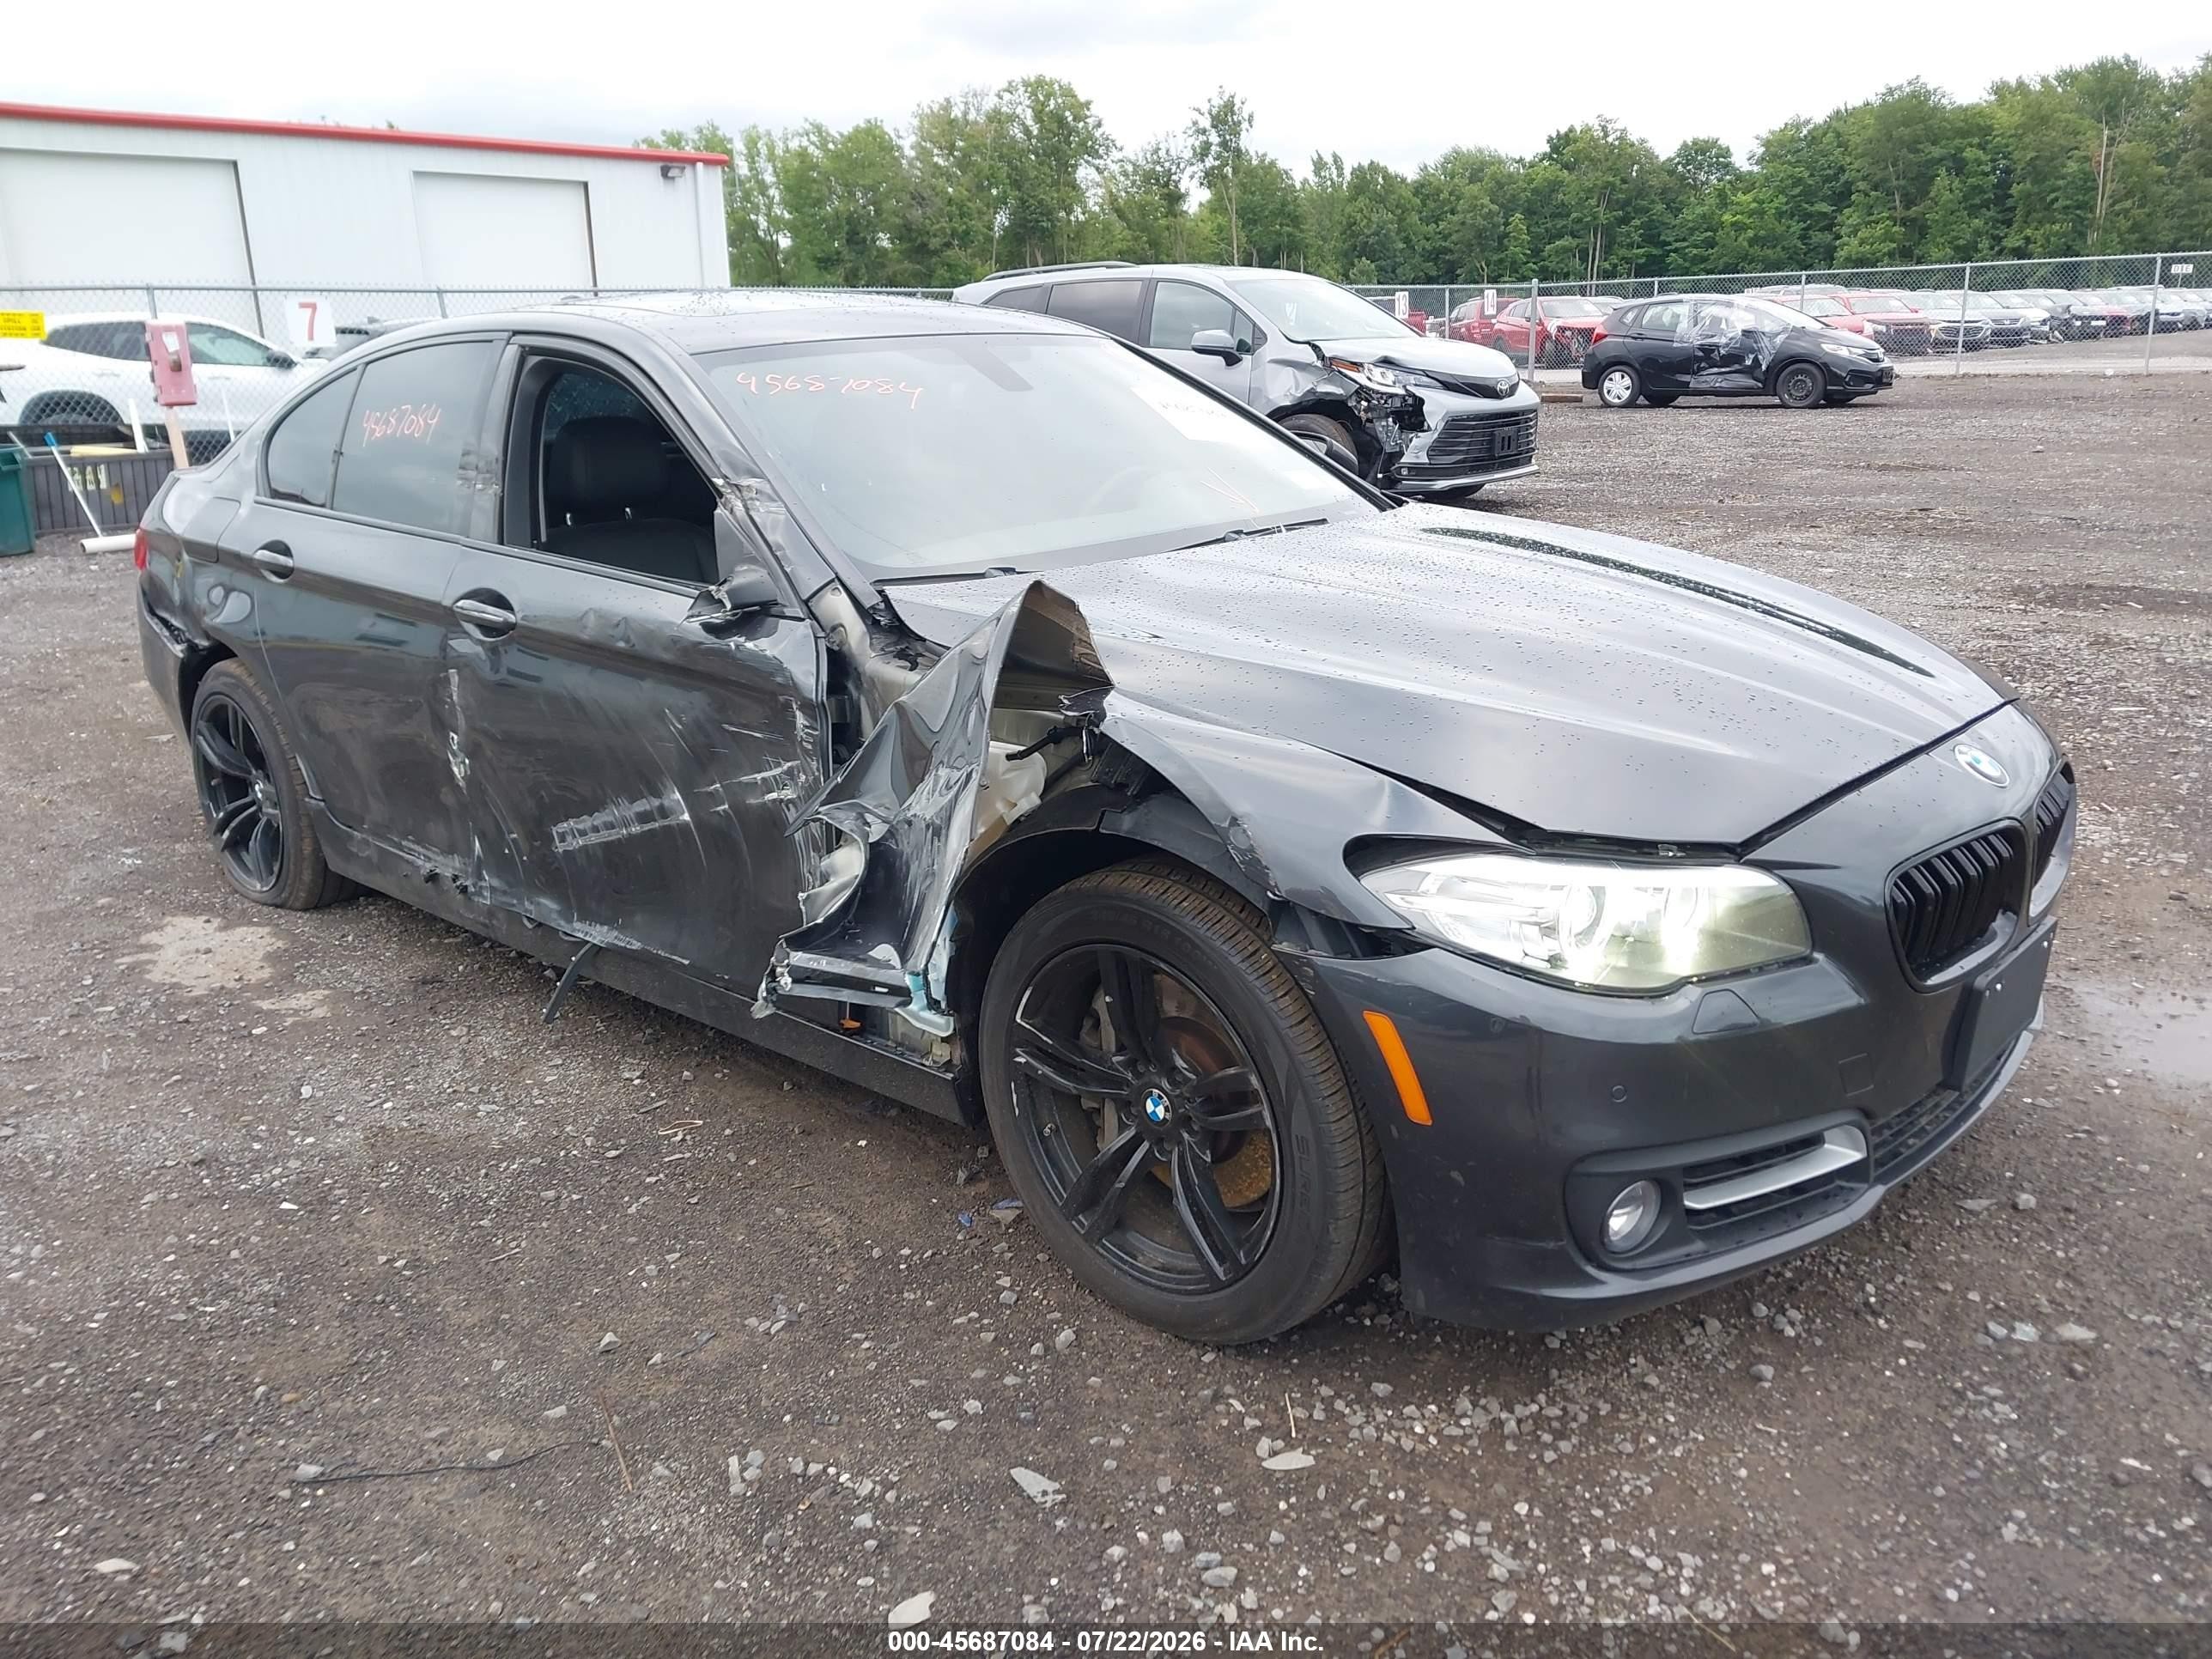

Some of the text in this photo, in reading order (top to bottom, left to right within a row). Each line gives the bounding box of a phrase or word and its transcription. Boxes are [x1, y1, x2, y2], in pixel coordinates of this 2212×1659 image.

[1397, 294, 1407, 316] 13
[1486, 292, 1495, 312] 14
[298, 301, 317, 342] 7
